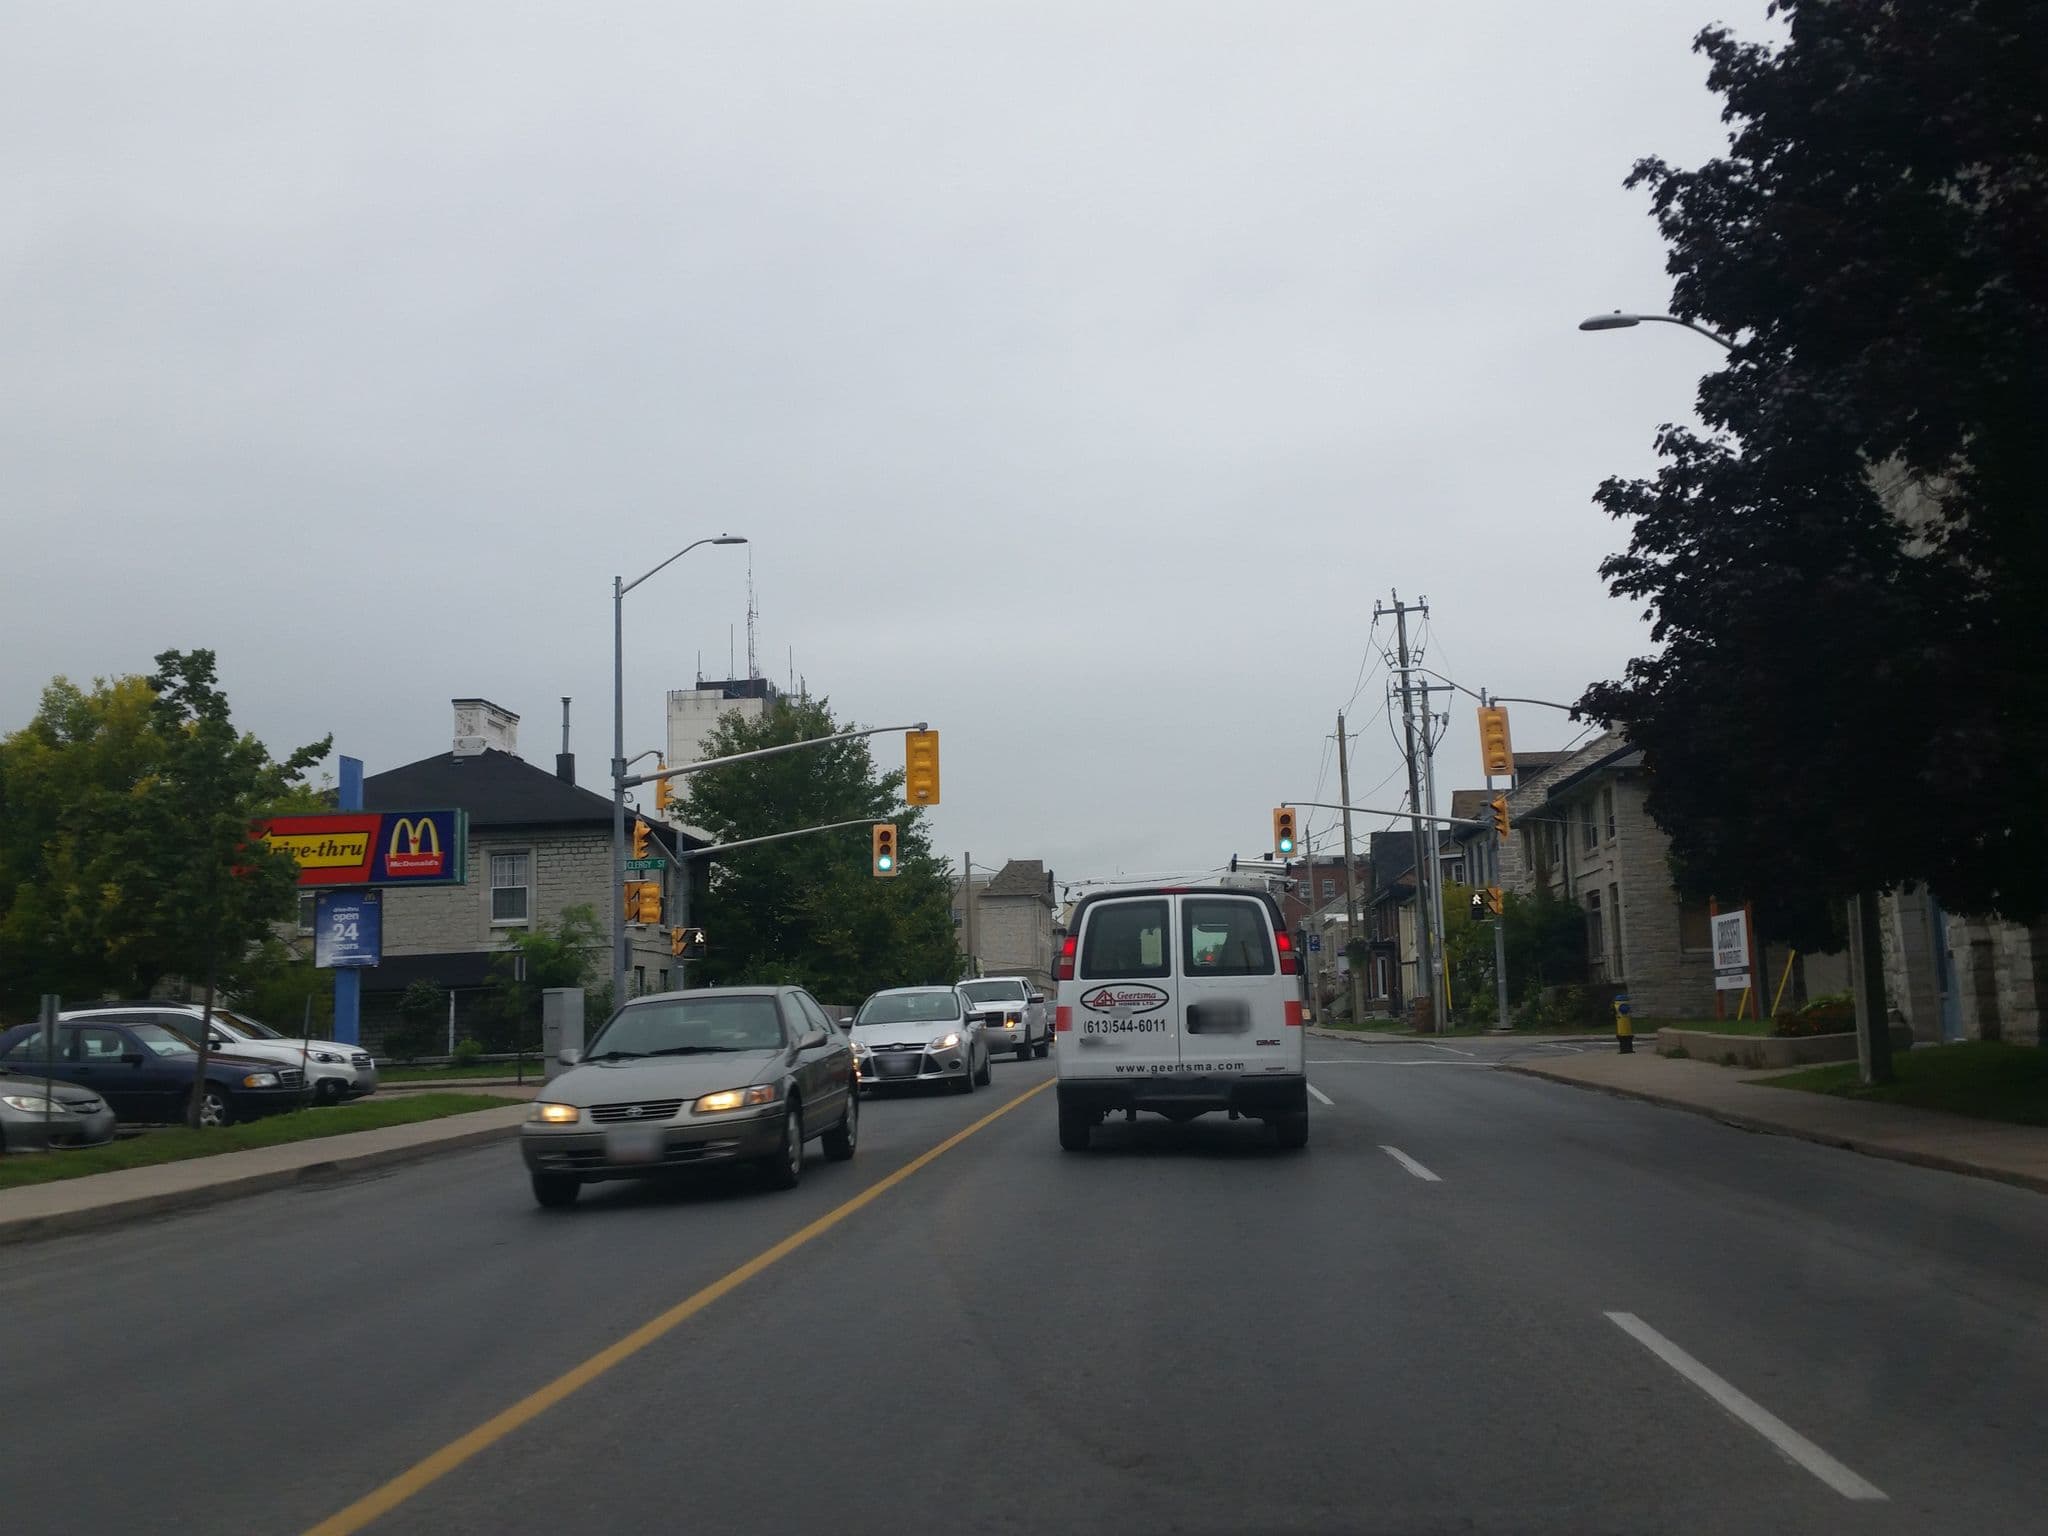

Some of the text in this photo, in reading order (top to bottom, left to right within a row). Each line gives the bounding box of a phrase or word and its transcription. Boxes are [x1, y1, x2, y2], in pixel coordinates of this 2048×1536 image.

[389, 860, 440, 868] McDonald's
[627, 860, 665, 869] CLERGY ST
[332, 912, 359, 923] open
[333, 922, 360, 942] 24
[1117, 991, 1157, 1000] Geertsma
[1084, 1018, 1166, 1034] (613)544-6011
[1115, 1062, 1245, 1074] www.geertsma.com
